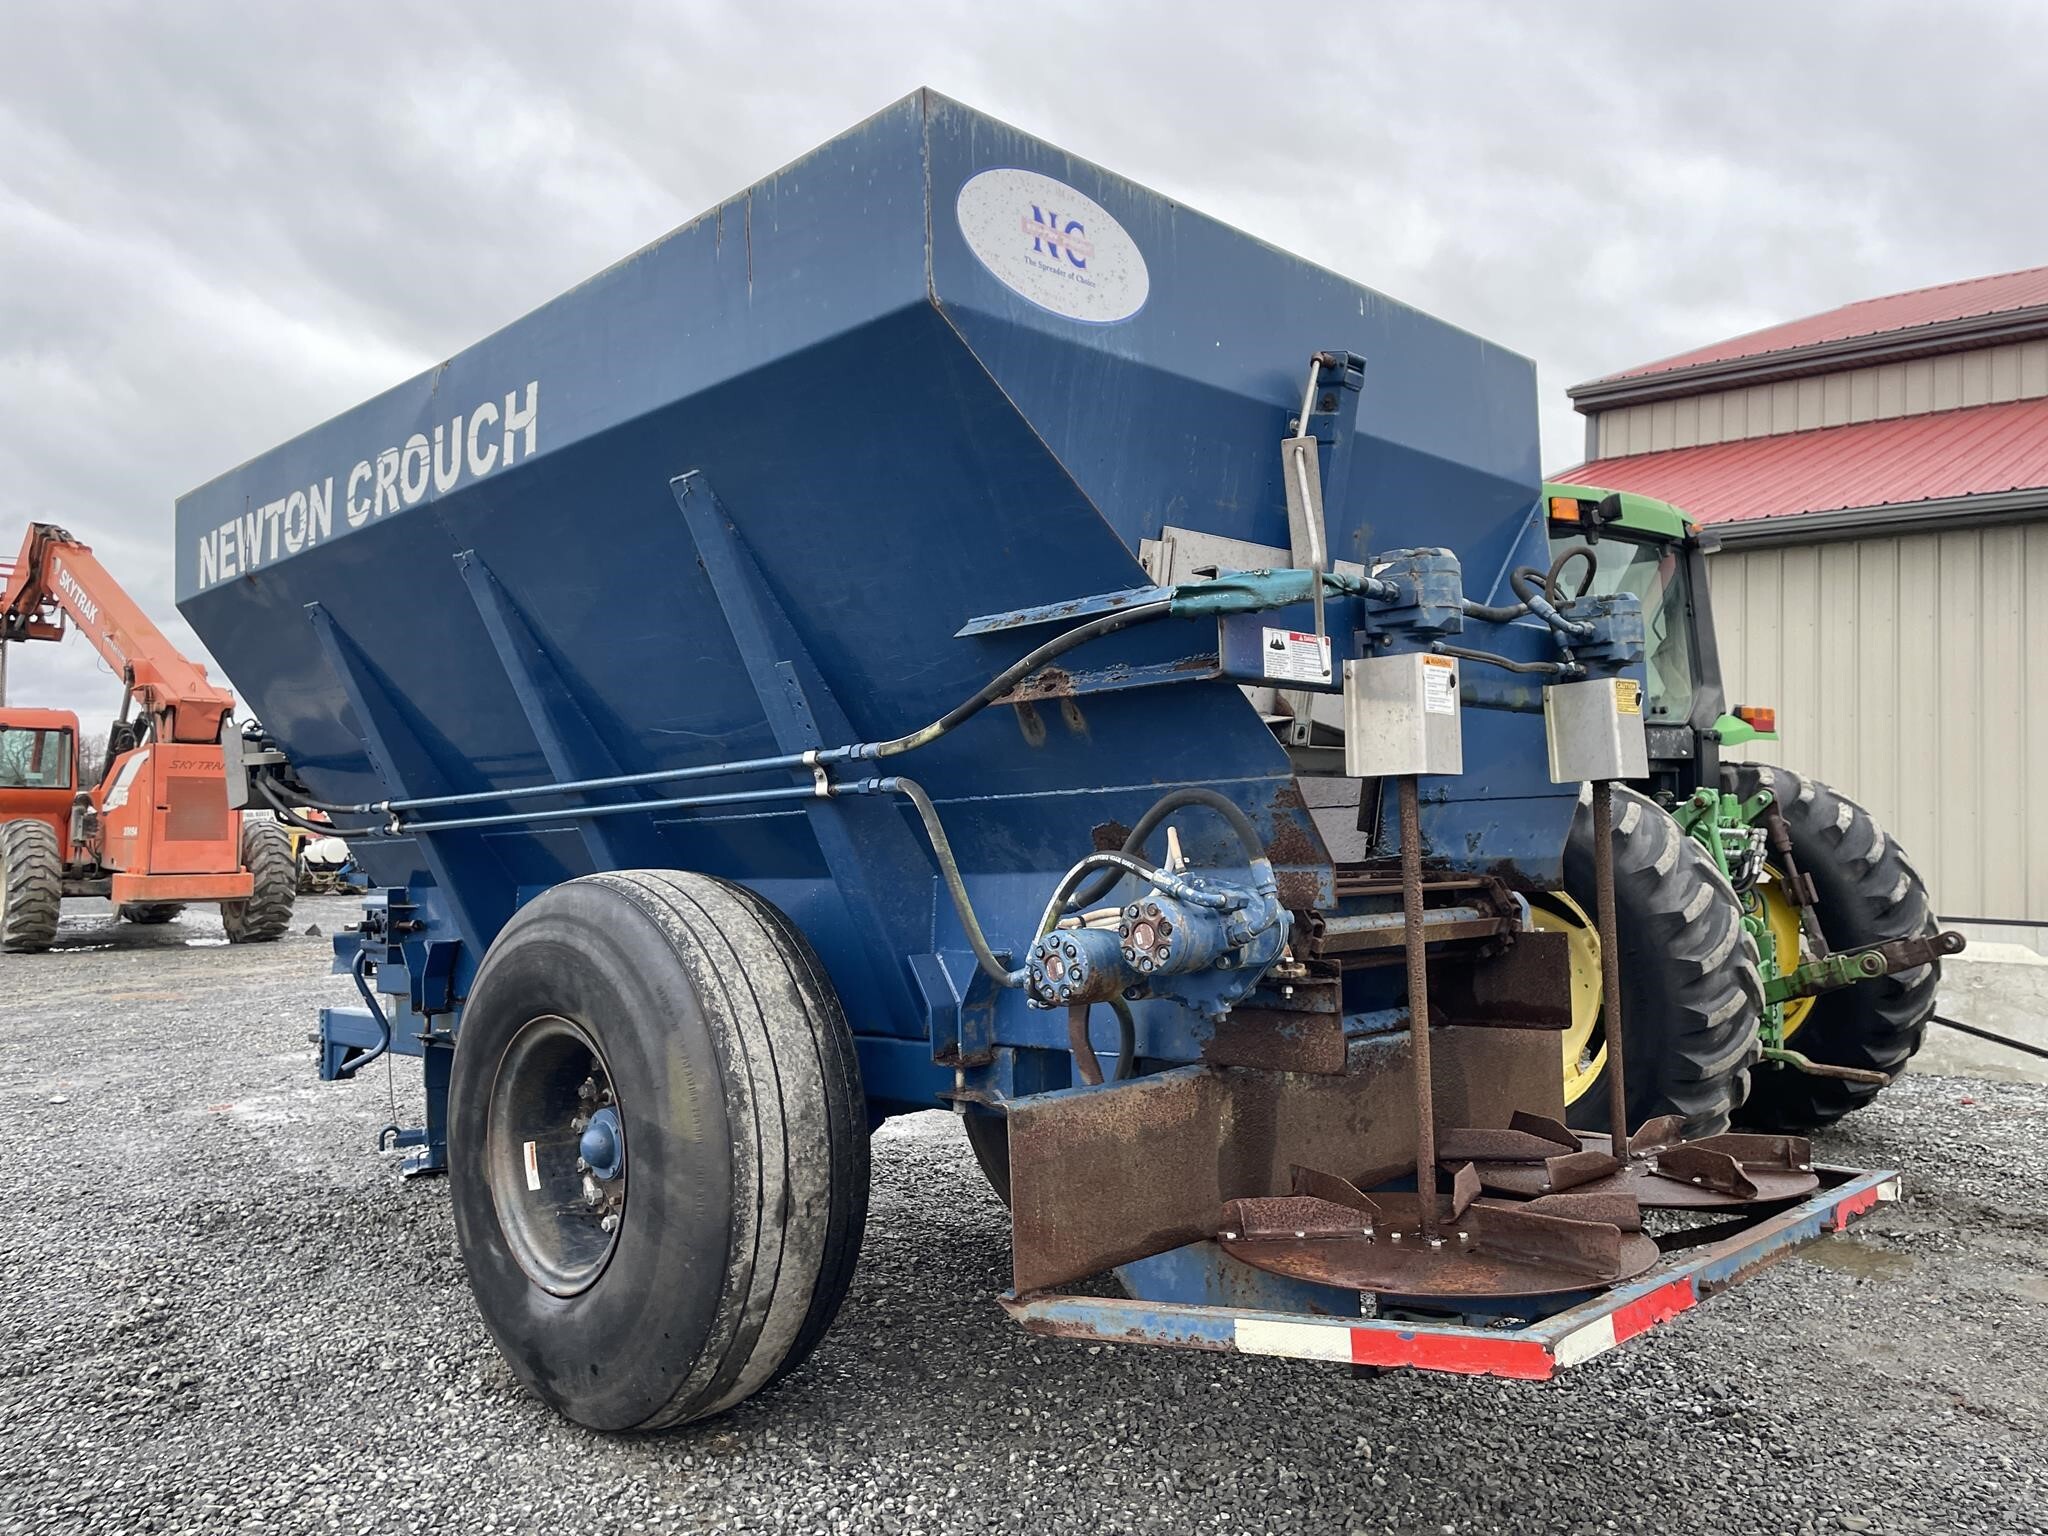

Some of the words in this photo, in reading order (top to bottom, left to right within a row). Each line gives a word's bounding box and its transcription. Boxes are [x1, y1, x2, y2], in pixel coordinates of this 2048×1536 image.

[1031, 204, 1087, 269] NC
[1024, 255, 1037, 267] The
[1038, 261, 1066, 277] Spreader
[1076, 274, 1096, 288] Choice
[198, 476, 334, 590] NEWTON
[346, 380, 539, 527] CROUCH
[59, 569, 98, 624] SKYTRAK
